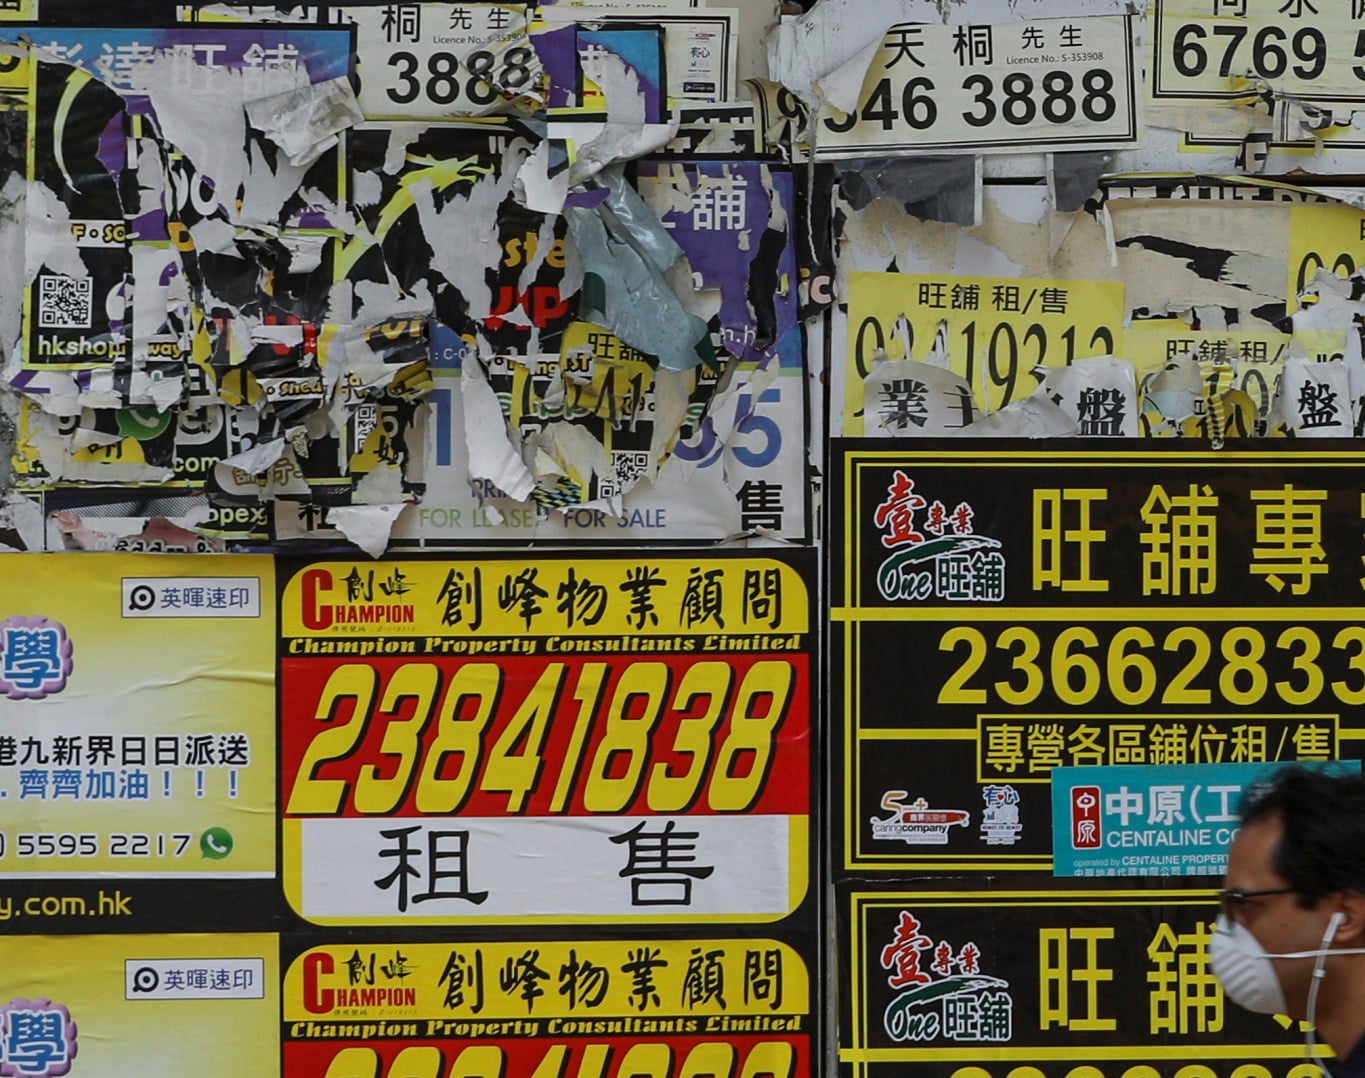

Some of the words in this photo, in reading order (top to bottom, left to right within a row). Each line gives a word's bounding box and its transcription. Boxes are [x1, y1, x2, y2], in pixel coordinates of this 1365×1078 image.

[450, 8, 509, 31] 先生
[1021, 25, 1083, 49] 先生
[1006, 55, 1038, 64] Licence
[1061, 52, 1103, 62] S-353908
[1173, 24, 1326, 80] 6769
[962, 70, 1115, 127] 3888
[919, 283, 981, 311] 旺舖
[992, 285, 1067, 316] 租/售
[736, 480, 784, 531] 售
[419, 508, 461, 528] FOR
[160, 585, 250, 609] 英暉速印
[436, 566, 783, 632] 創峰物業顧問
[285, 659, 792, 815] 23841838
[1107, 829, 1211, 847] CENTALINE
[1074, 859, 1108, 867] operated
[1110, 859, 1120, 867] by
[1122, 855, 1179, 866] CENTALINE
[163, 967, 253, 991] 英暉速印
[304, 952, 416, 1014] CHAMPION
[438, 947, 783, 1012] 創峰物業顧問
[290, 1019, 416, 1039] Champion
[427, 1019, 538, 1039] Property
[547, 1017, 697, 1035] Consultants
[706, 1015, 802, 1033] Limited
